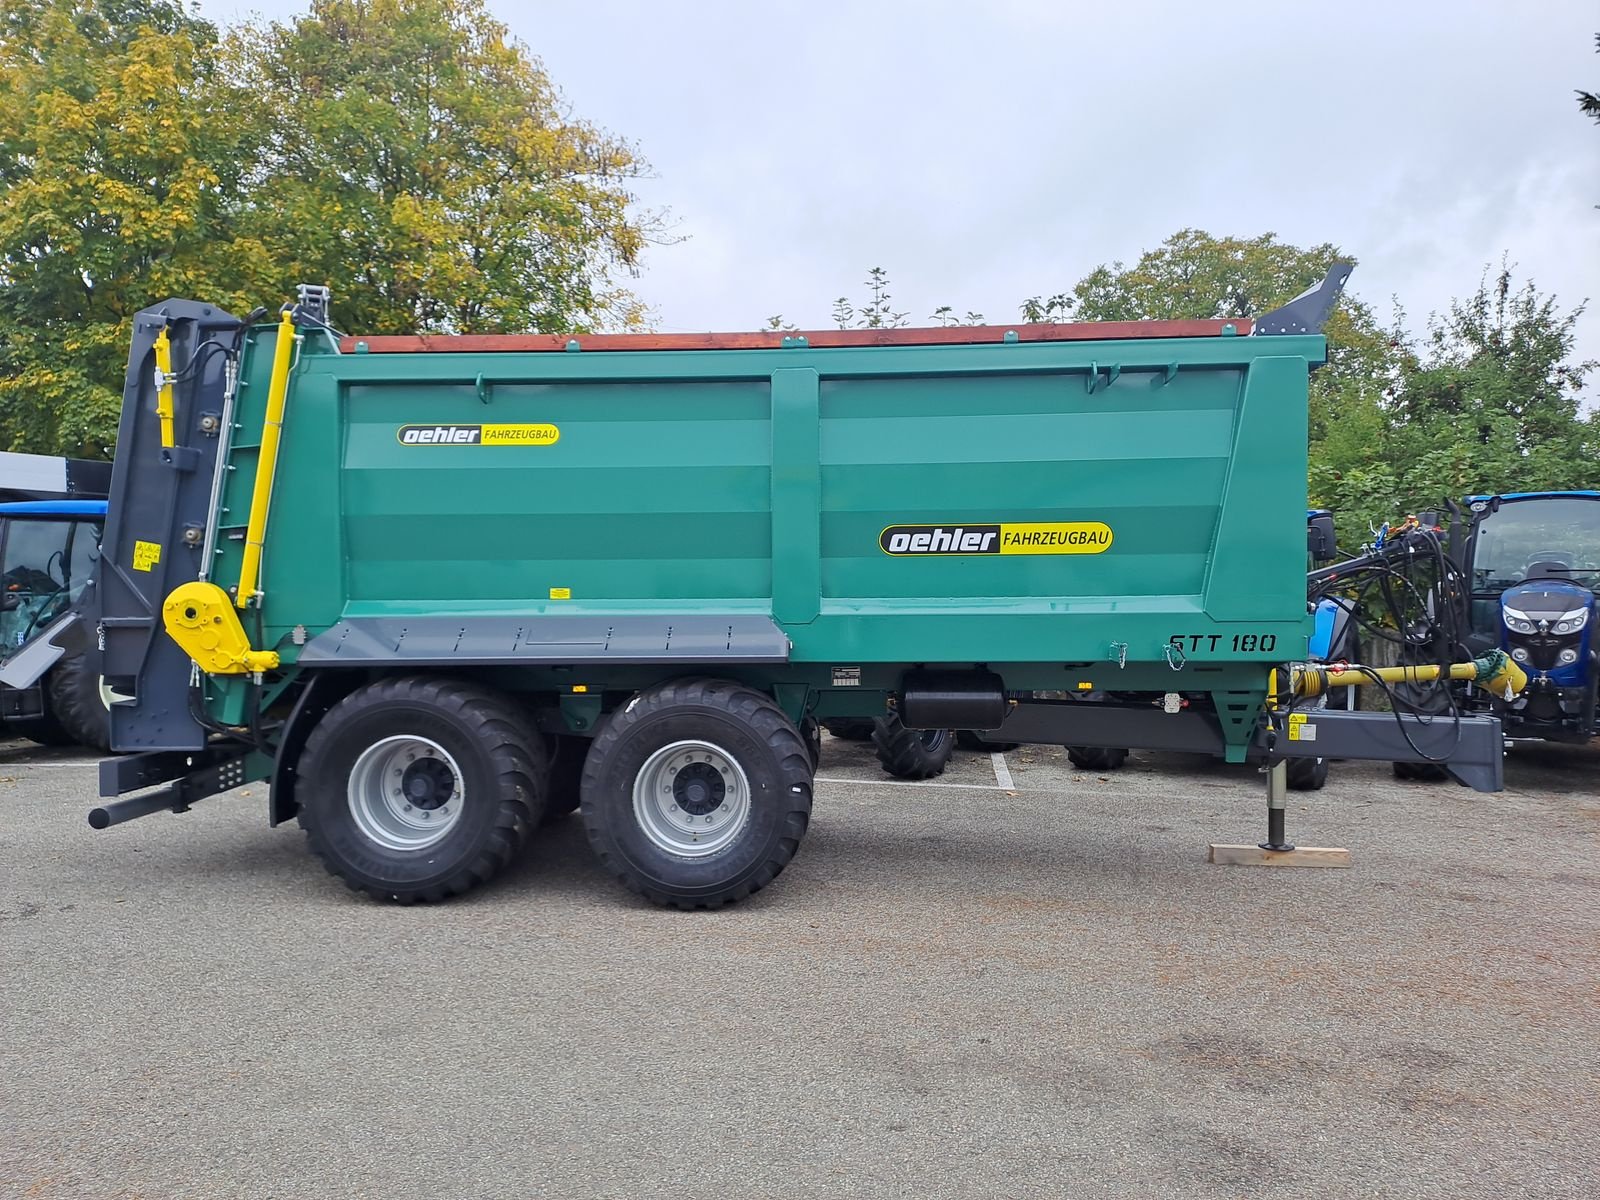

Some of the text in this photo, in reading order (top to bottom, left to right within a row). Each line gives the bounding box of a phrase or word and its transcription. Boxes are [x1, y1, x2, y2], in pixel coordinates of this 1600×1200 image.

[402, 426, 557, 444] oehler FAHRZEUGBAU
[889, 528, 1110, 553] oehler FAHRZEUGBAU
[1169, 634, 1277, 653] STT 180
